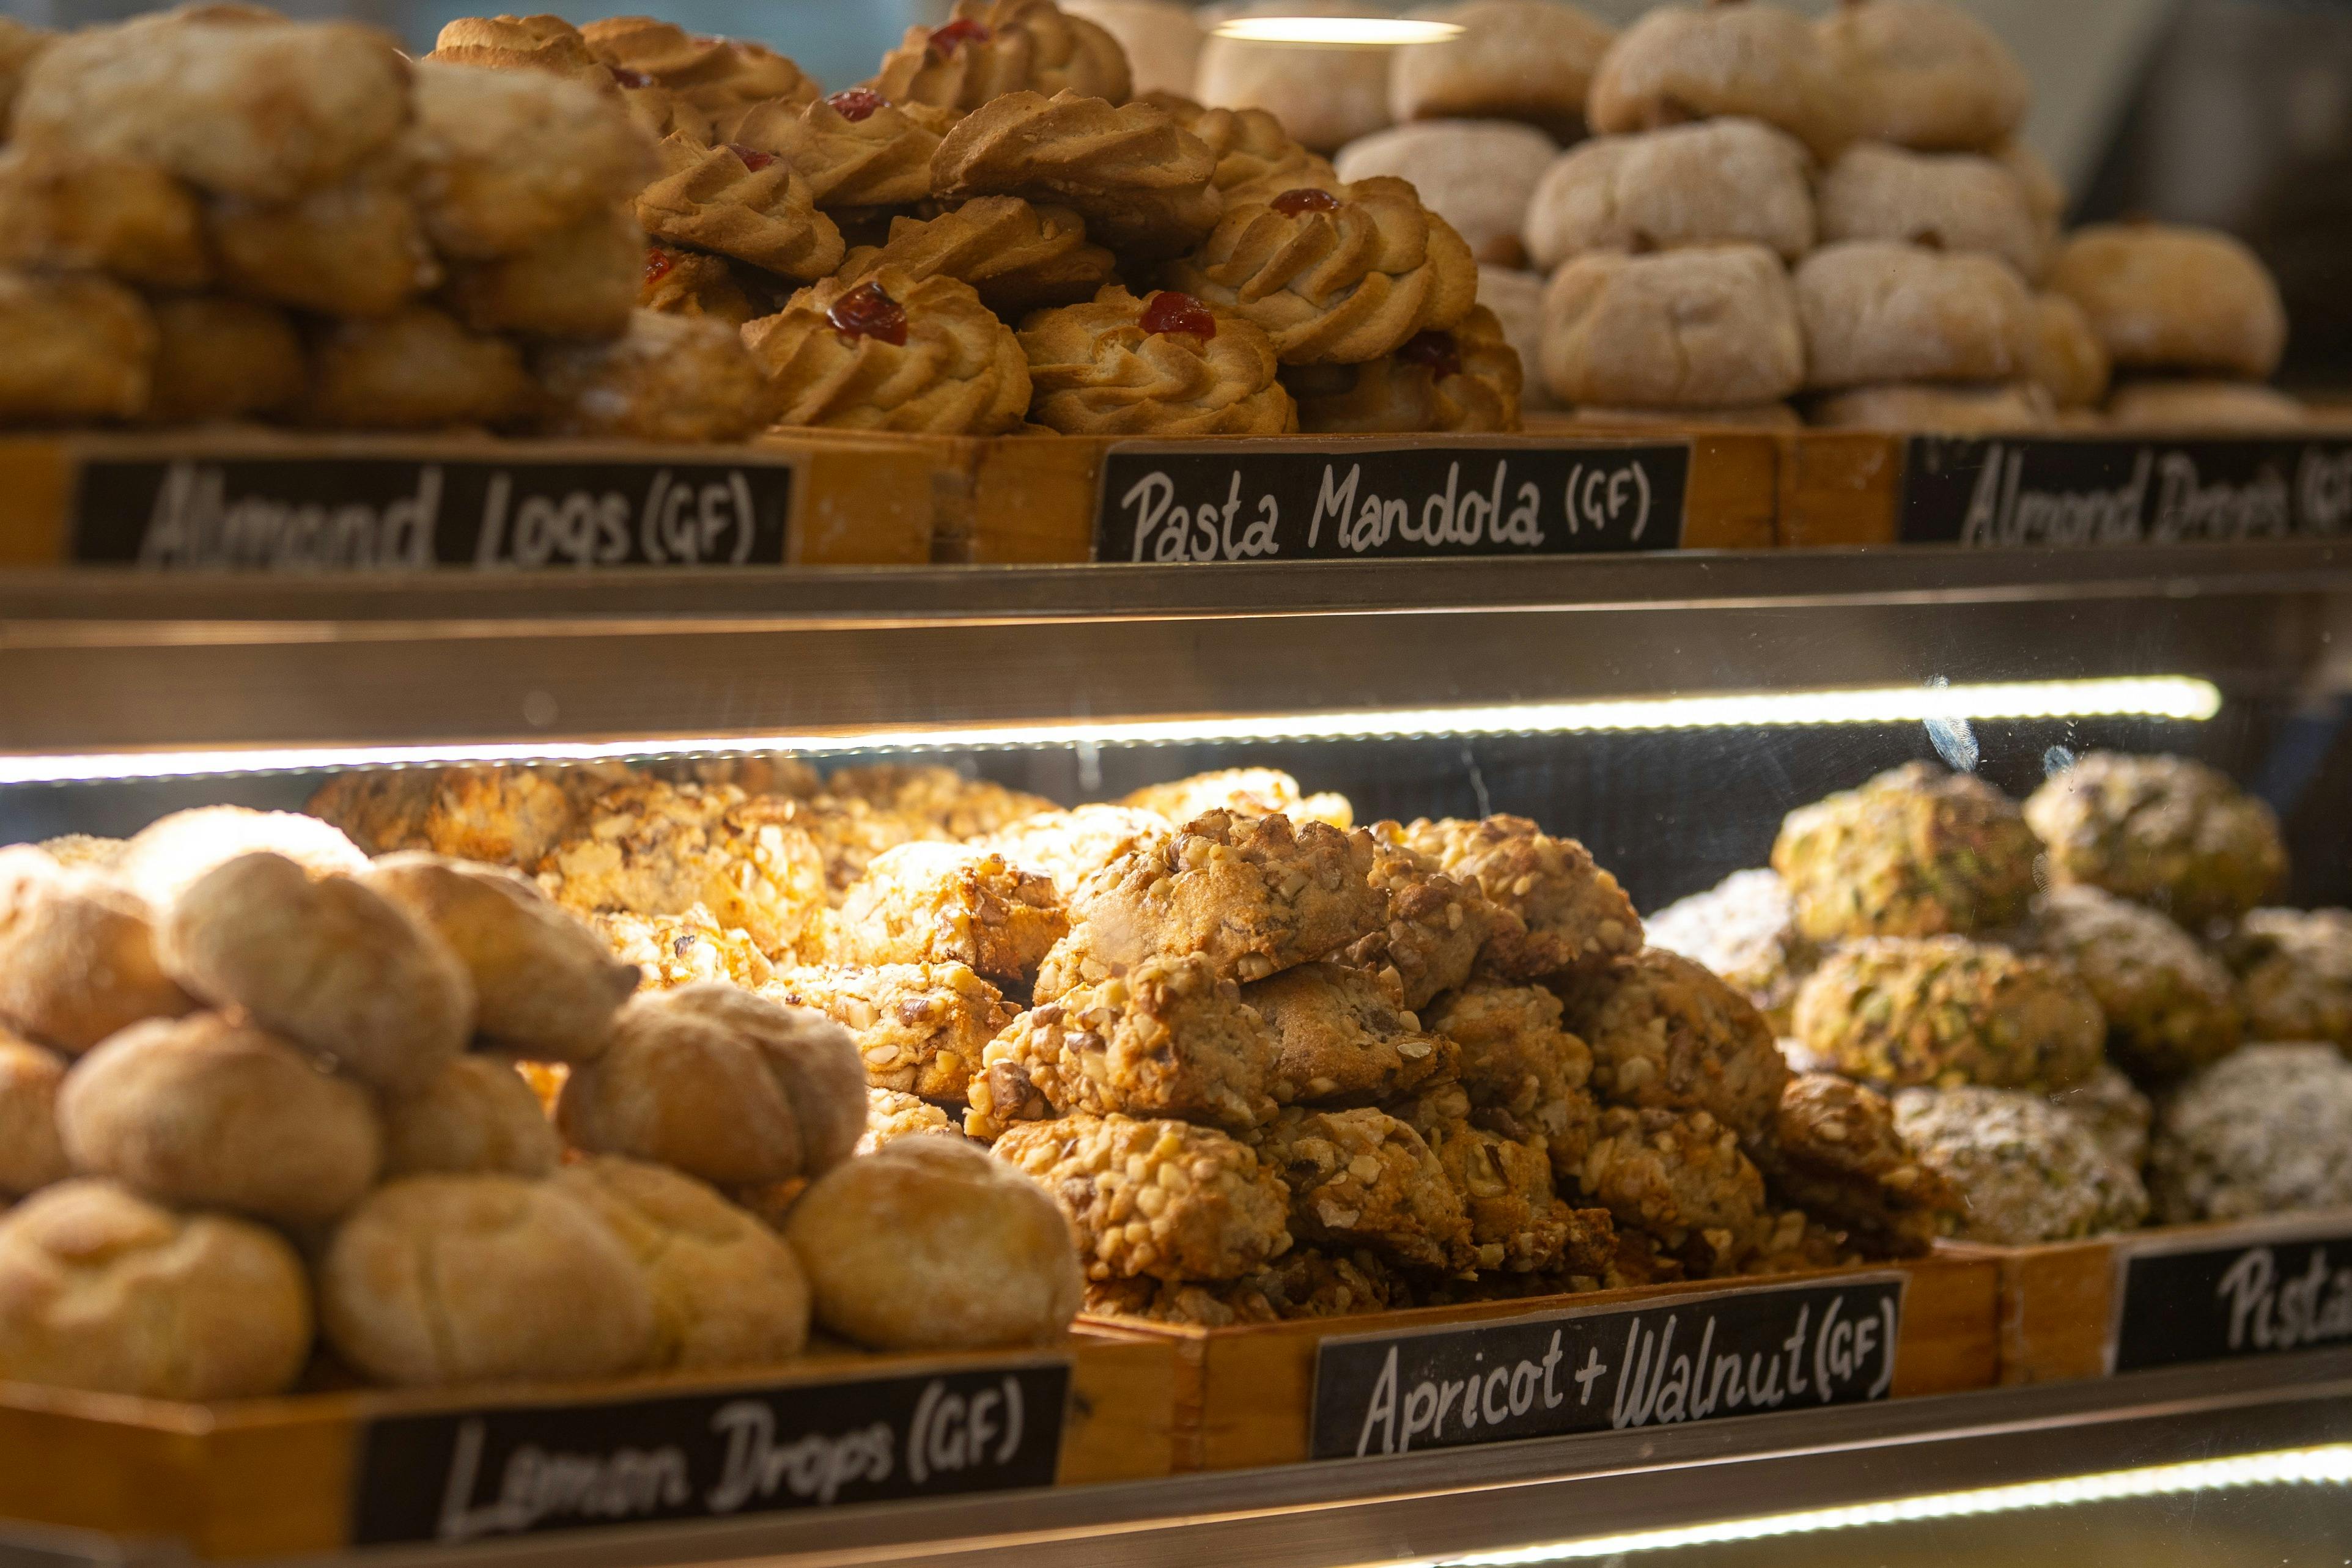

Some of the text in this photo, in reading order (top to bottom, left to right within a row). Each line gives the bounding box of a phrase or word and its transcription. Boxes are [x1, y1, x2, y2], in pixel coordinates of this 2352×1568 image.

[476, 471, 632, 566] Logs
[641, 472, 753, 562] (GF)
[1122, 461, 1651, 561] Pasta Mandola (GF)
[1357, 1295, 1895, 1456] Apricot + Walnut (GF)
[437, 1379, 1024, 1542] Lemon Drops (GF)
